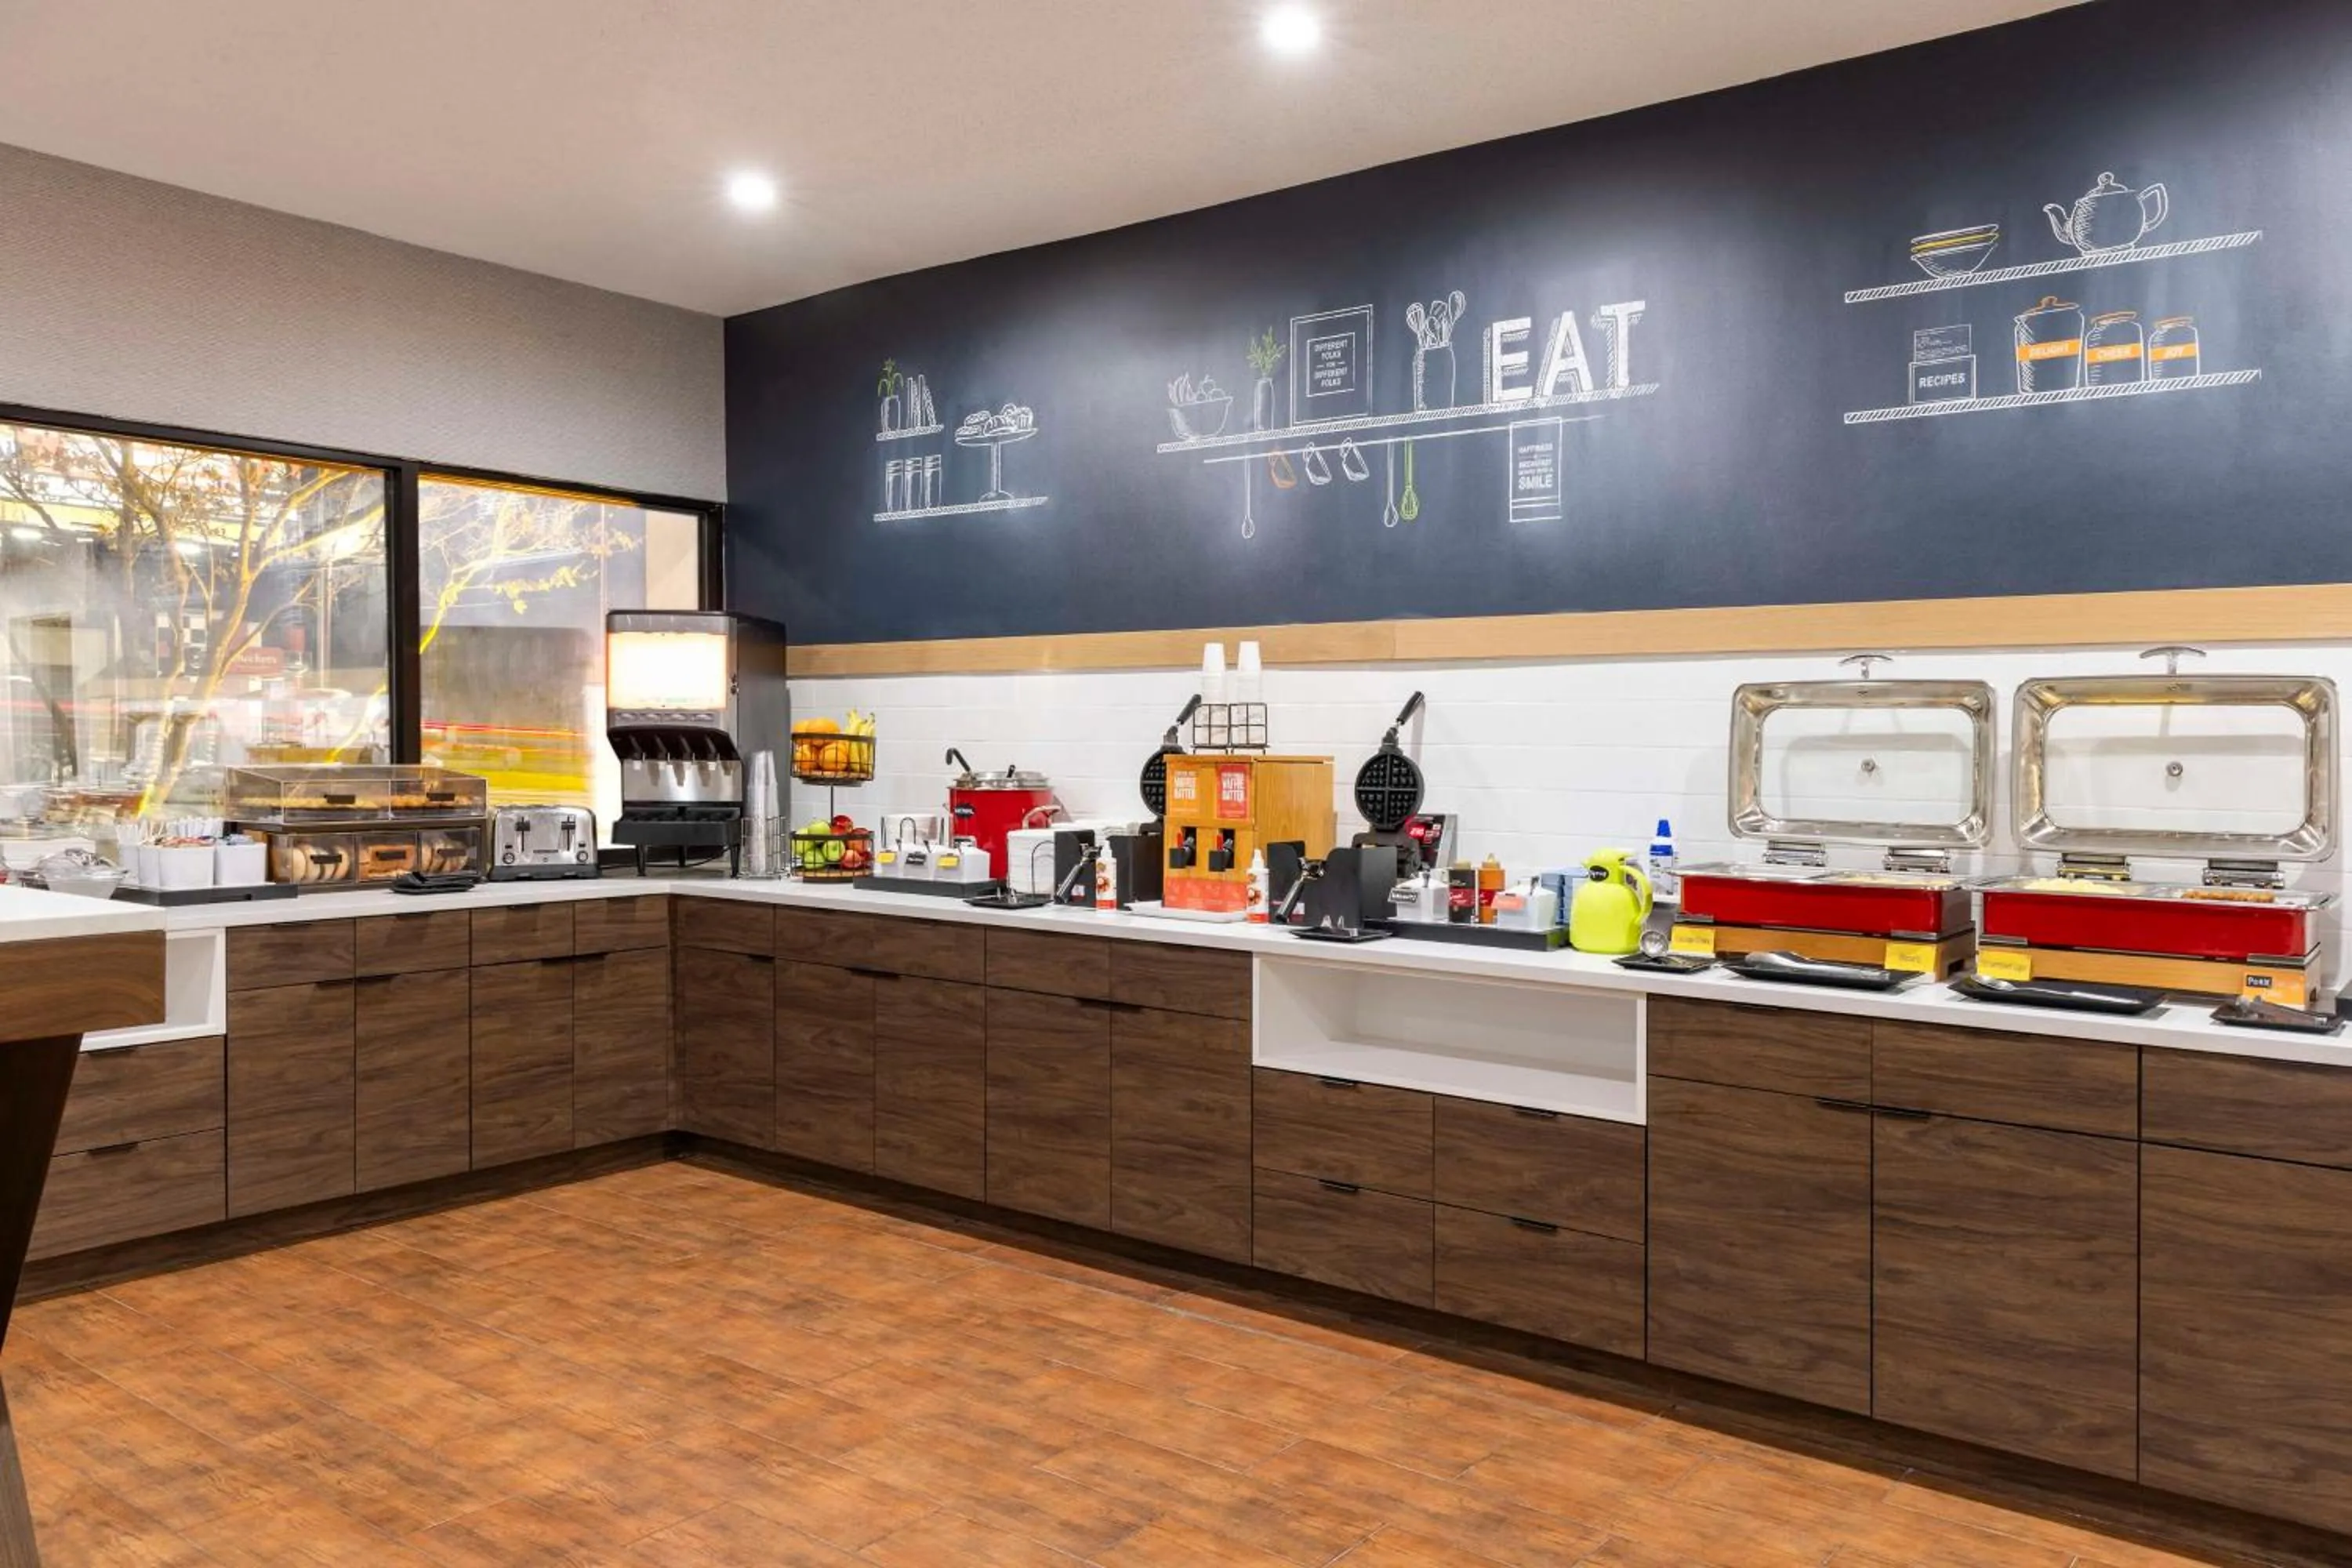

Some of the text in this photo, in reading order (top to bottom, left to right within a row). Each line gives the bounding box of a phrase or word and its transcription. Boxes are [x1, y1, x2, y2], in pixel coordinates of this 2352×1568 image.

[1314, 339, 1348, 352] DIFFERENT
[1484, 300, 1646, 404] EAT
[1314, 366, 1348, 380] DIFFERENT
[1918, 373, 1966, 389] RECIPES
[1518, 474, 1553, 490] SMILE
